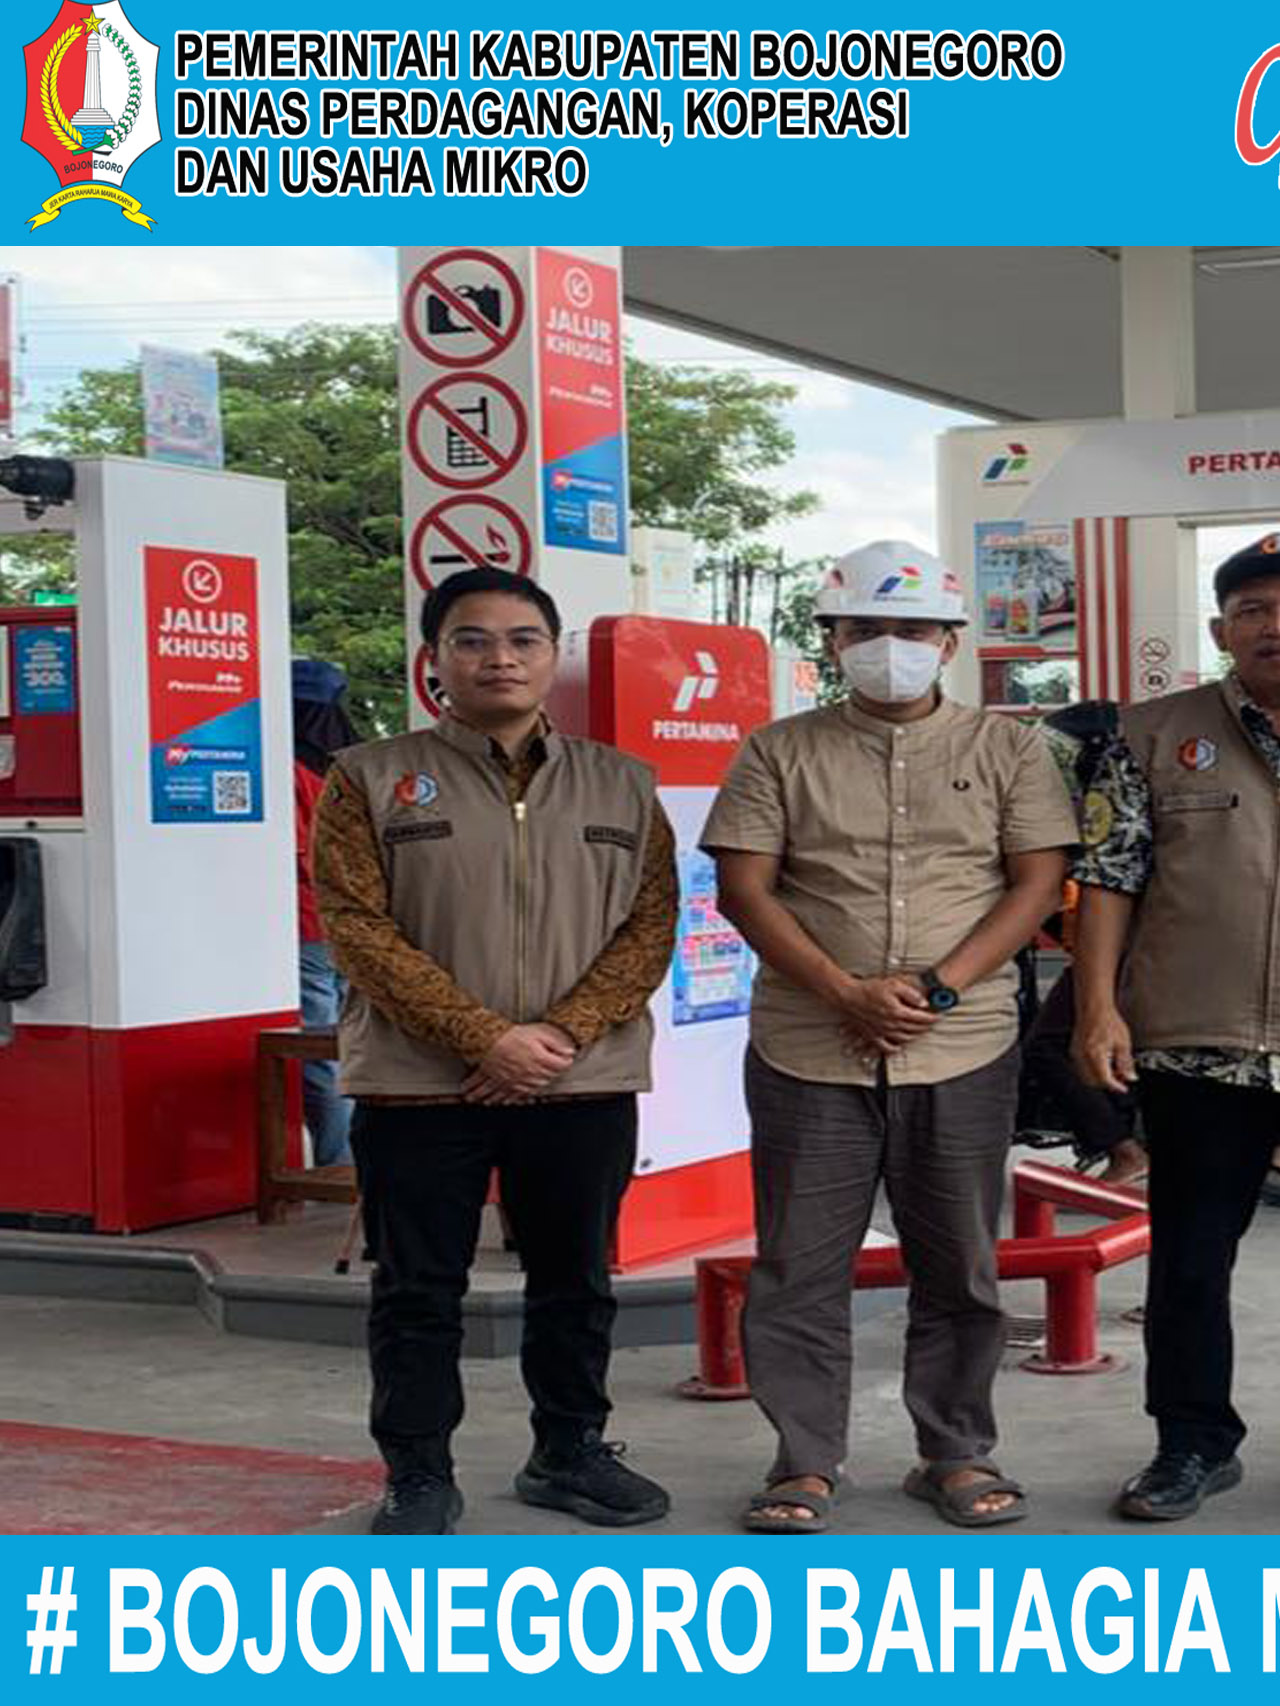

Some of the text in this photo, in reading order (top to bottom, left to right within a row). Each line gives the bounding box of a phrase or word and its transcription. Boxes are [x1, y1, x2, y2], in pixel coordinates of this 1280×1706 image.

[546, 307, 612, 343] JALUR
[159, 607, 249, 638] JALUR
[158, 636, 250, 662] KHUSUS
